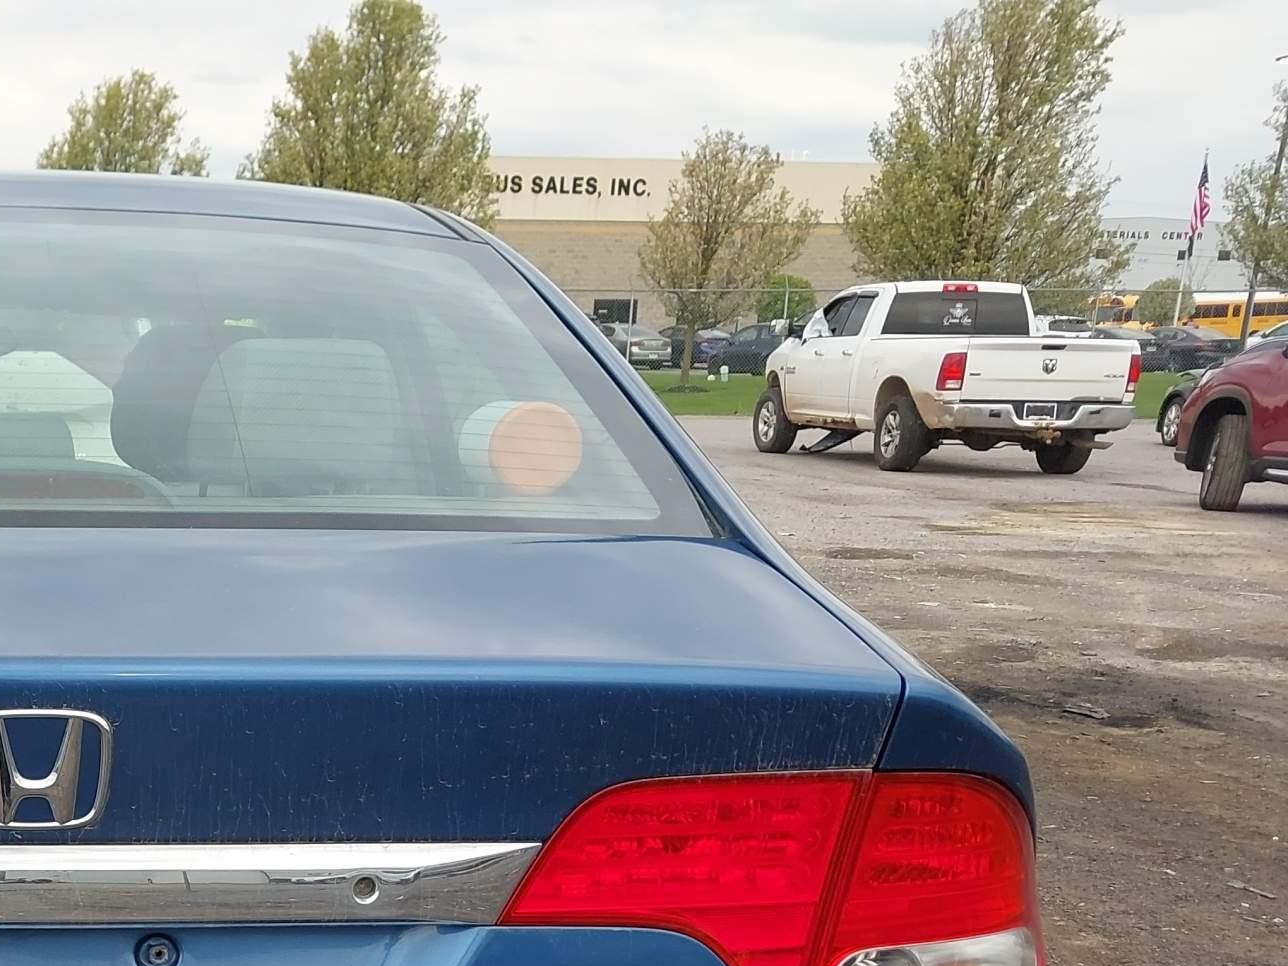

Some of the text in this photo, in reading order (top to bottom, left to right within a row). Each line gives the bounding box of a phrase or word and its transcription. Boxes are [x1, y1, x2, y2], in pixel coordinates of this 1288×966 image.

[530, 175, 602, 198] SALES,
[610, 177, 651, 197] INC.
[1099, 230, 1204, 240] TERIALS CENTR
